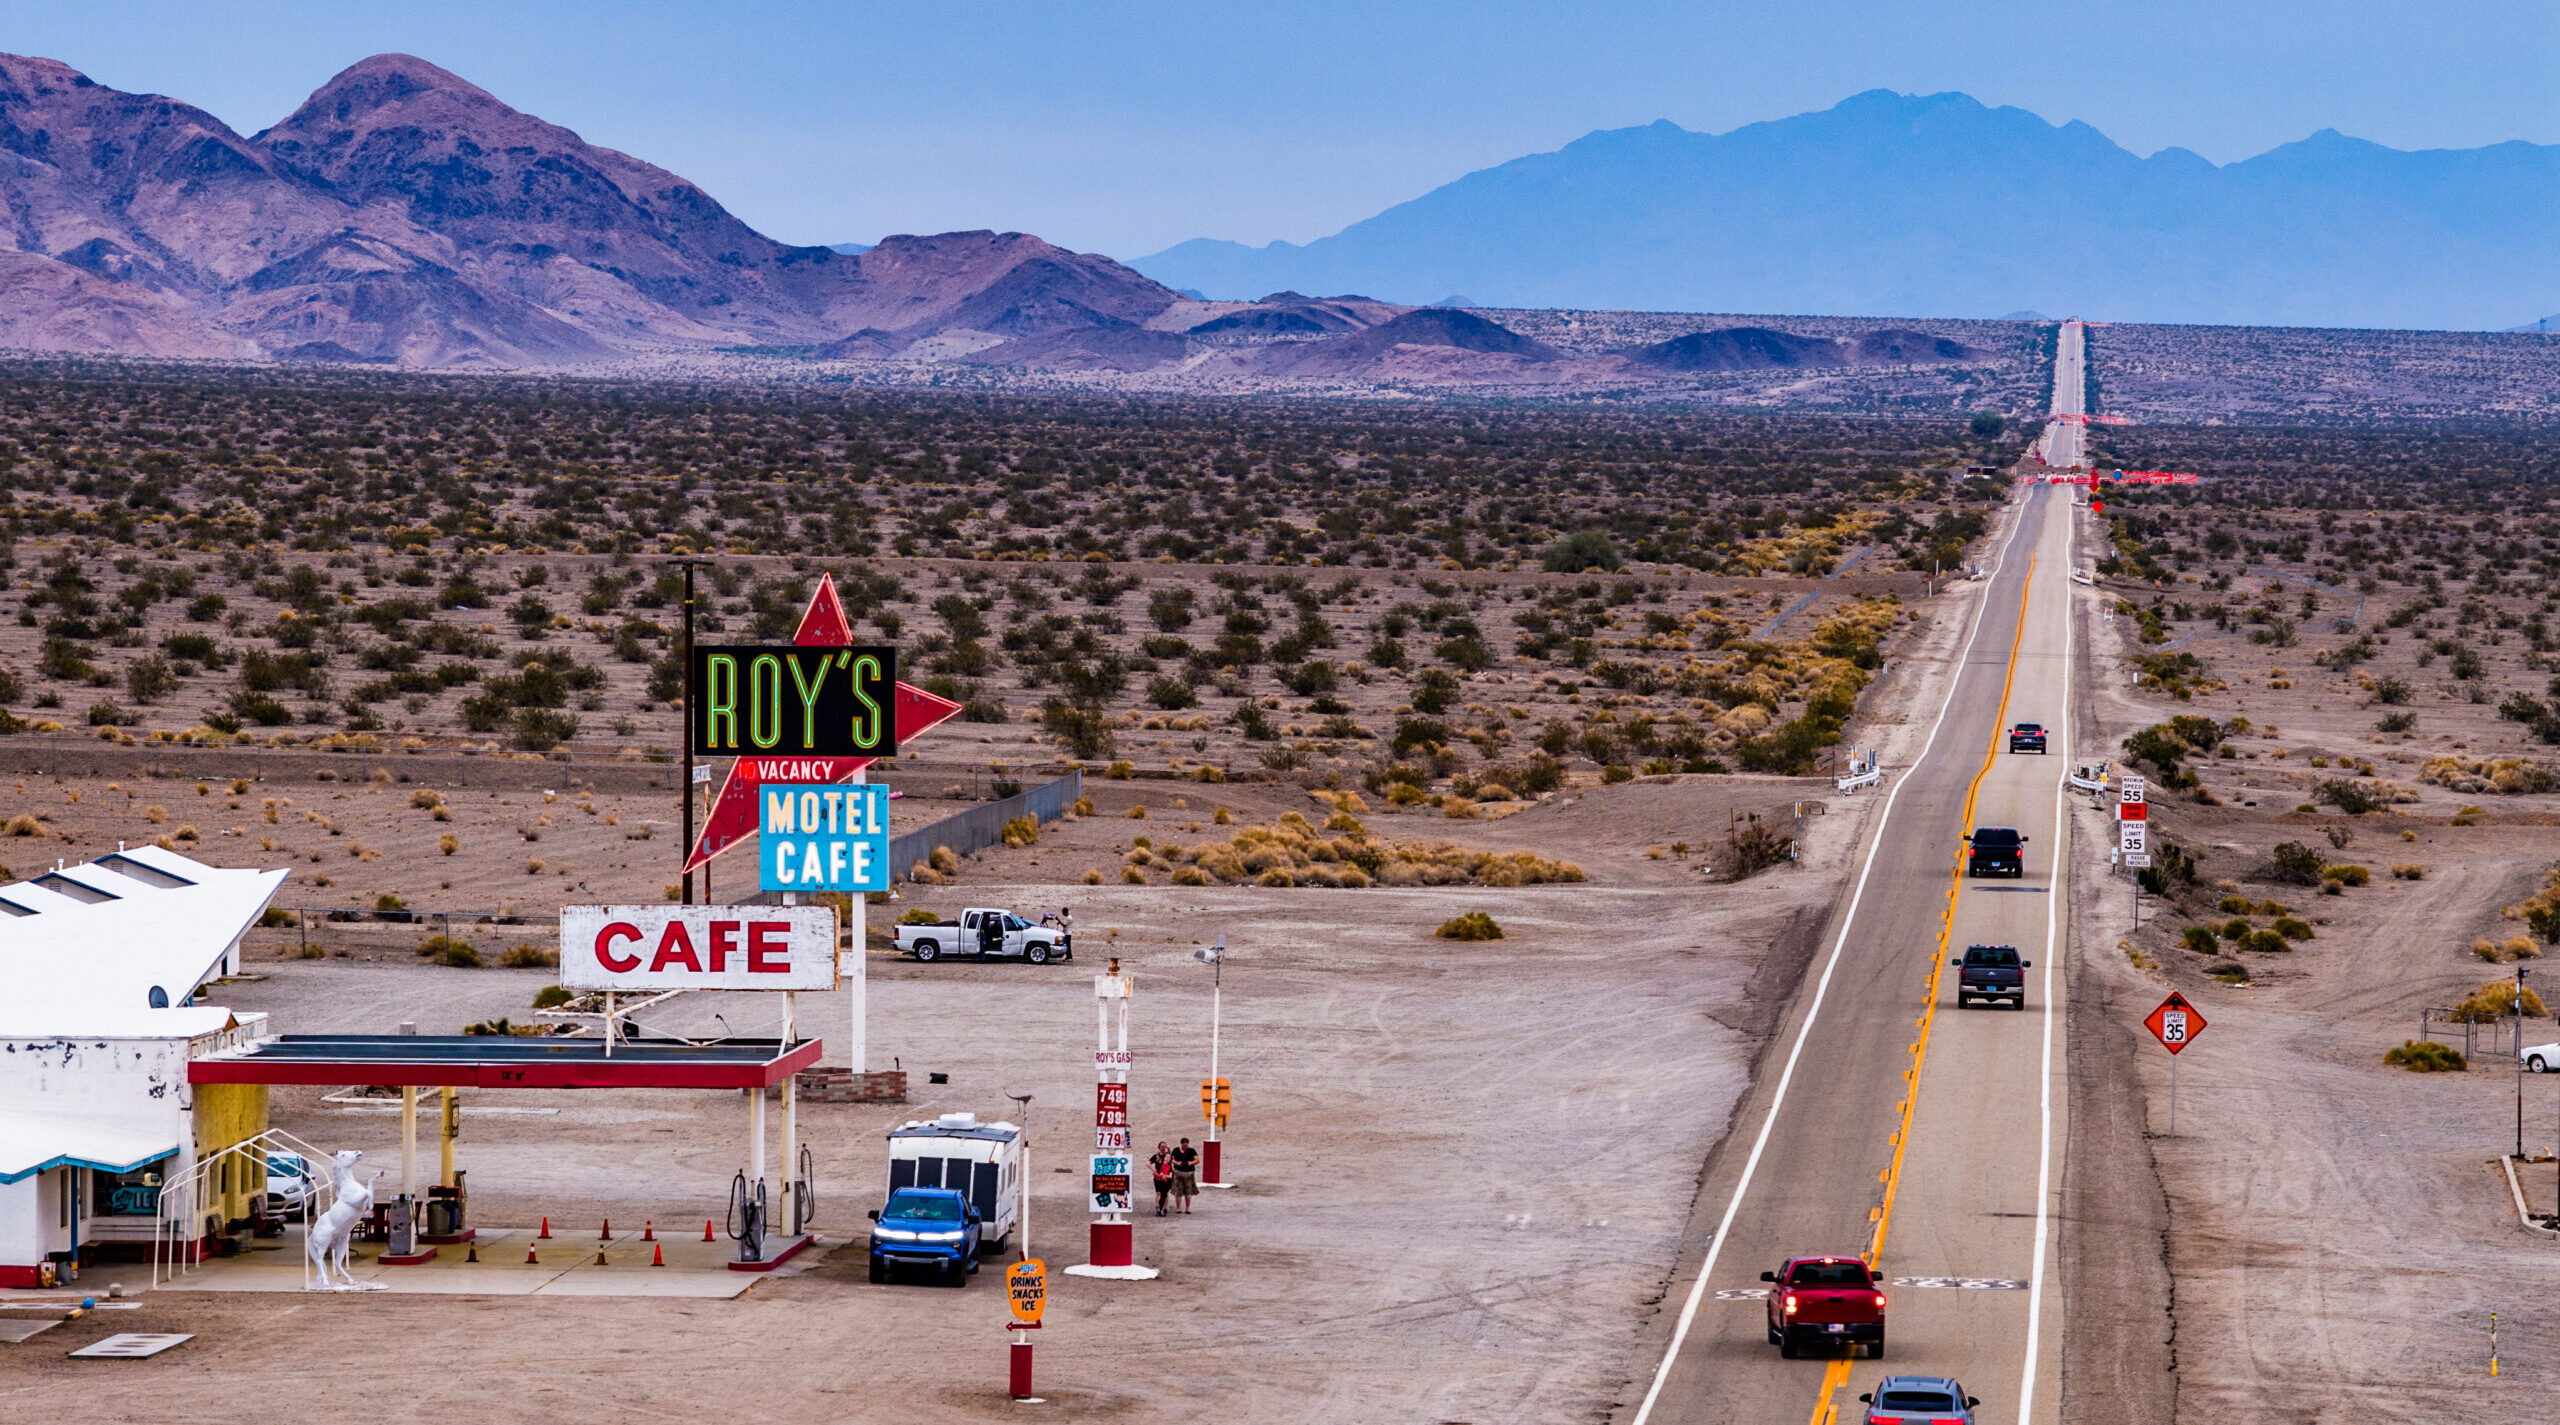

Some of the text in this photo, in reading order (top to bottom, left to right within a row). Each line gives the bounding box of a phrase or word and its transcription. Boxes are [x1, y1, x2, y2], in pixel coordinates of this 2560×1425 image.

[707, 649, 881, 748] ROY'S
[757, 761, 834, 780] VACANCY
[2123, 790, 2141, 802] 55
[768, 792, 882, 835] MOTEL
[2124, 839, 2142, 850] 35
[776, 841, 871, 884] CAFE
[594, 920, 792, 974] CAFE
[2166, 1023, 2184, 1041] 35
[1096, 1052, 1131, 1063] ROY'S GAS
[1011, 1276, 1043, 1287] DRINKS
[1012, 1288, 1044, 1300] SNACKS
[1021, 1300, 1036, 1311] ICE
